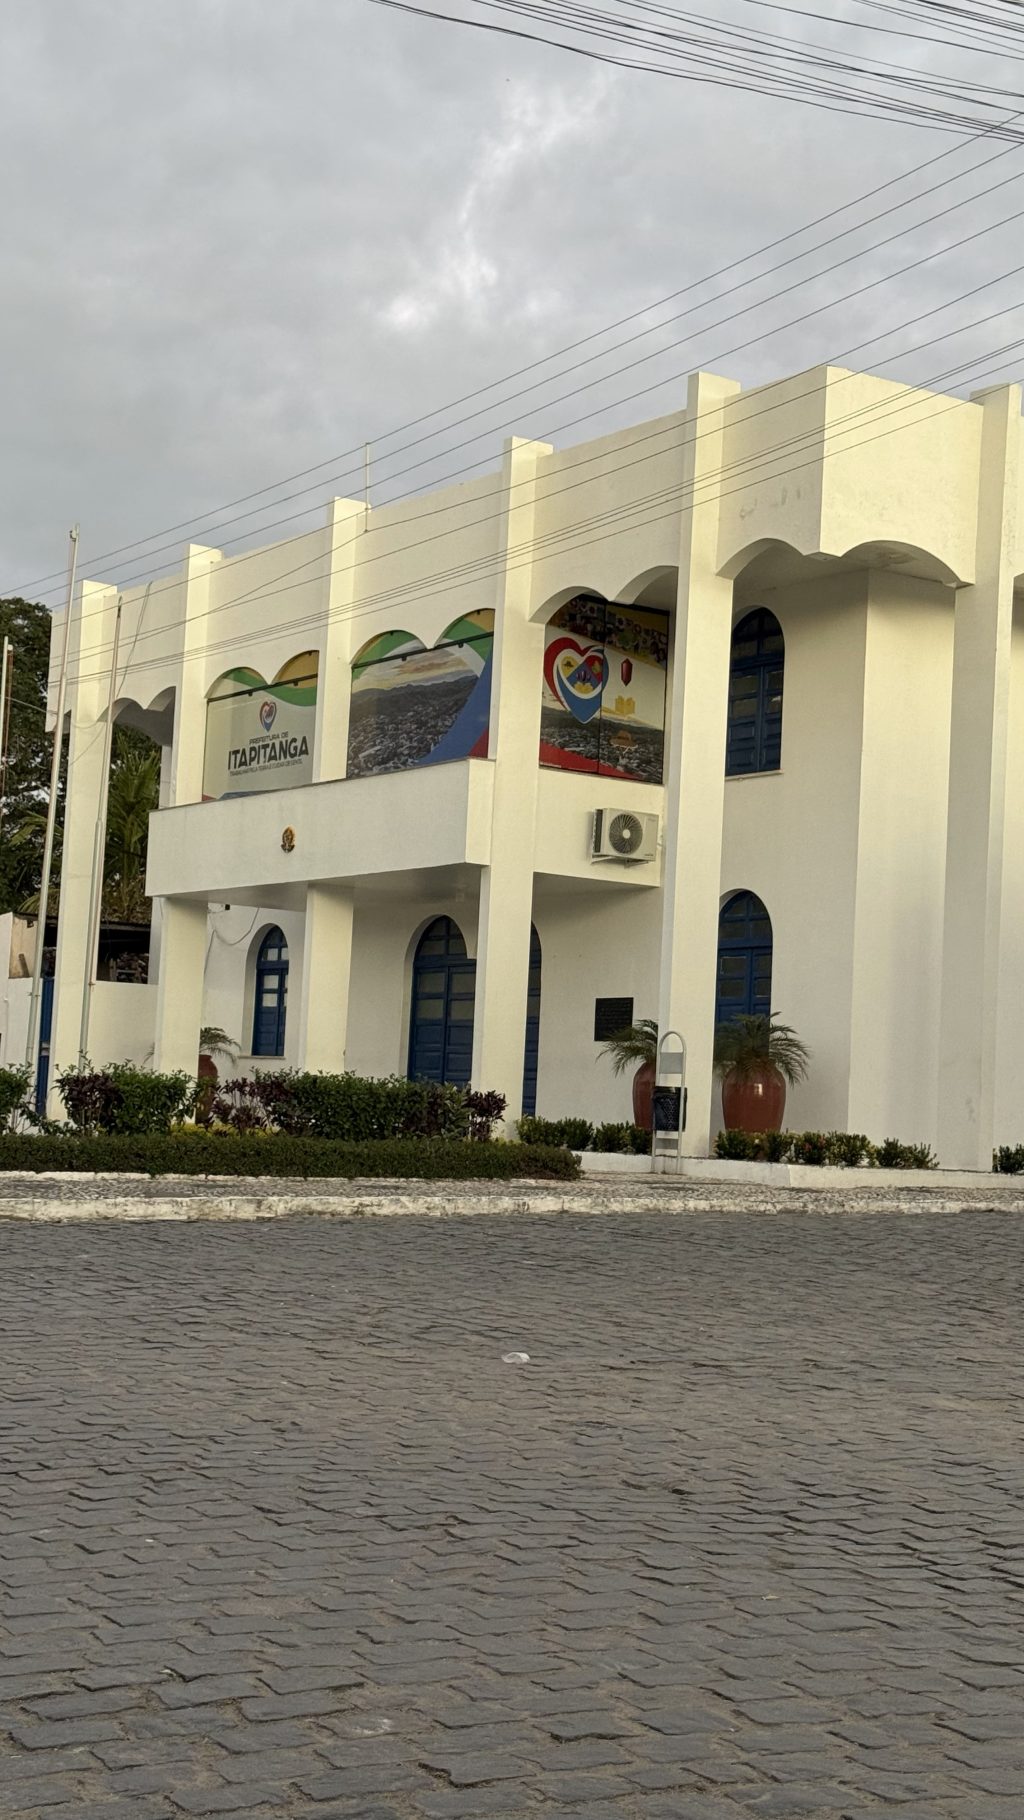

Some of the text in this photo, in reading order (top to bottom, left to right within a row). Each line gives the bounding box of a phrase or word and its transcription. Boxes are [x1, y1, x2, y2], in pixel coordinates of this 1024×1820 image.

[249, 731, 288, 745] PREFEITURA DE
[228, 736, 309, 770] ITAPITANGA
